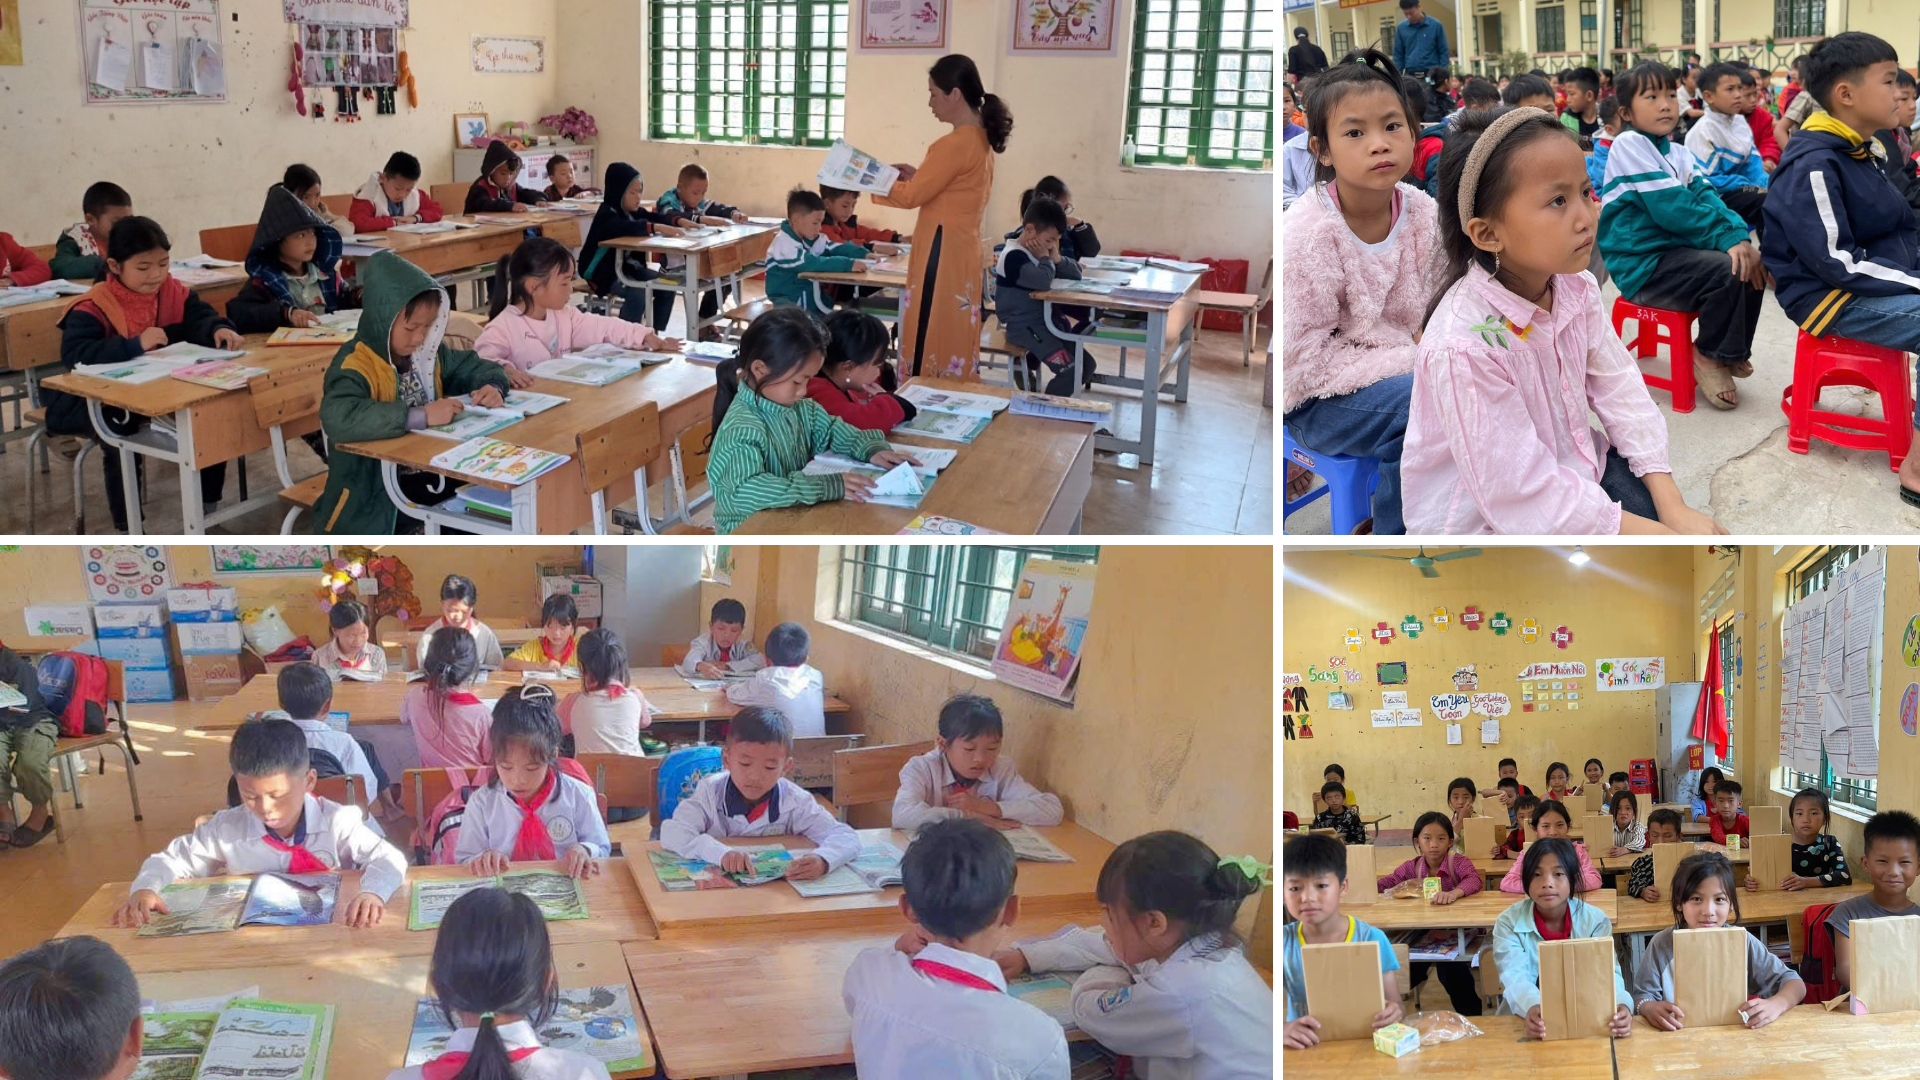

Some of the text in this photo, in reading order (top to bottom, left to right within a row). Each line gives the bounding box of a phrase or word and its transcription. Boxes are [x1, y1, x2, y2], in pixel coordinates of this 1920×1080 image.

[1637, 309, 1659, 322] 3AK
[1534, 665, 1549, 676] Em
[1431, 695, 1449, 708] Em
[1690, 746, 1702, 758] LỚP
[1692, 760, 1700, 768] 5A
